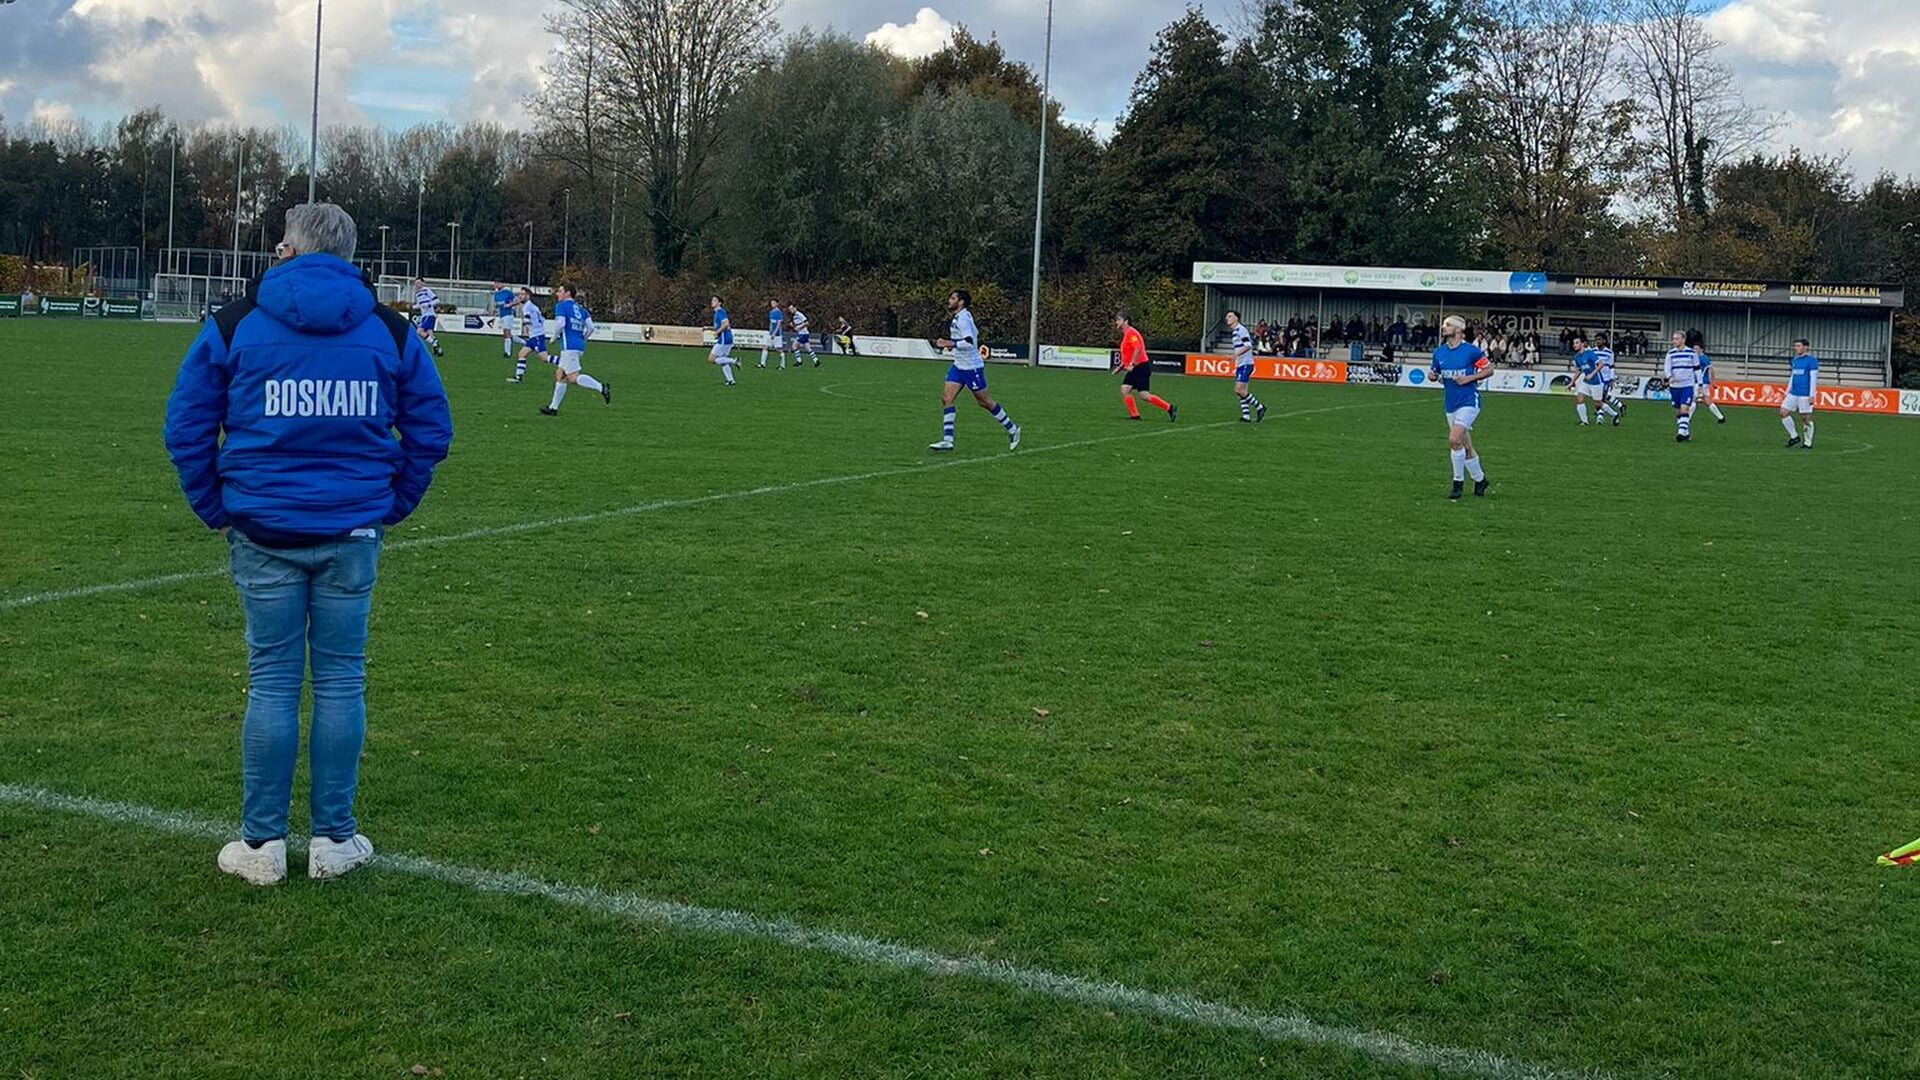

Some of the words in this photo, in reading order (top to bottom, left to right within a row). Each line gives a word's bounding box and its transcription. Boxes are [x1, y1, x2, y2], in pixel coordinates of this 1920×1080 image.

[1574, 278, 1658, 289] PLINTENFABRIEK.NL
[1683, 281, 1694, 289] DE
[1720, 283, 1767, 292] AFWERKING
[1682, 288, 1703, 296] VOOR
[1790, 285, 1881, 297] PLINTENFABRIEK.NL
[1195, 359, 1230, 374] ING
[1274, 363, 1311, 378] ING
[1523, 375, 1536, 389] 75
[264, 378, 379, 417] BOSKANT
[1713, 386, 1756, 402] ING
